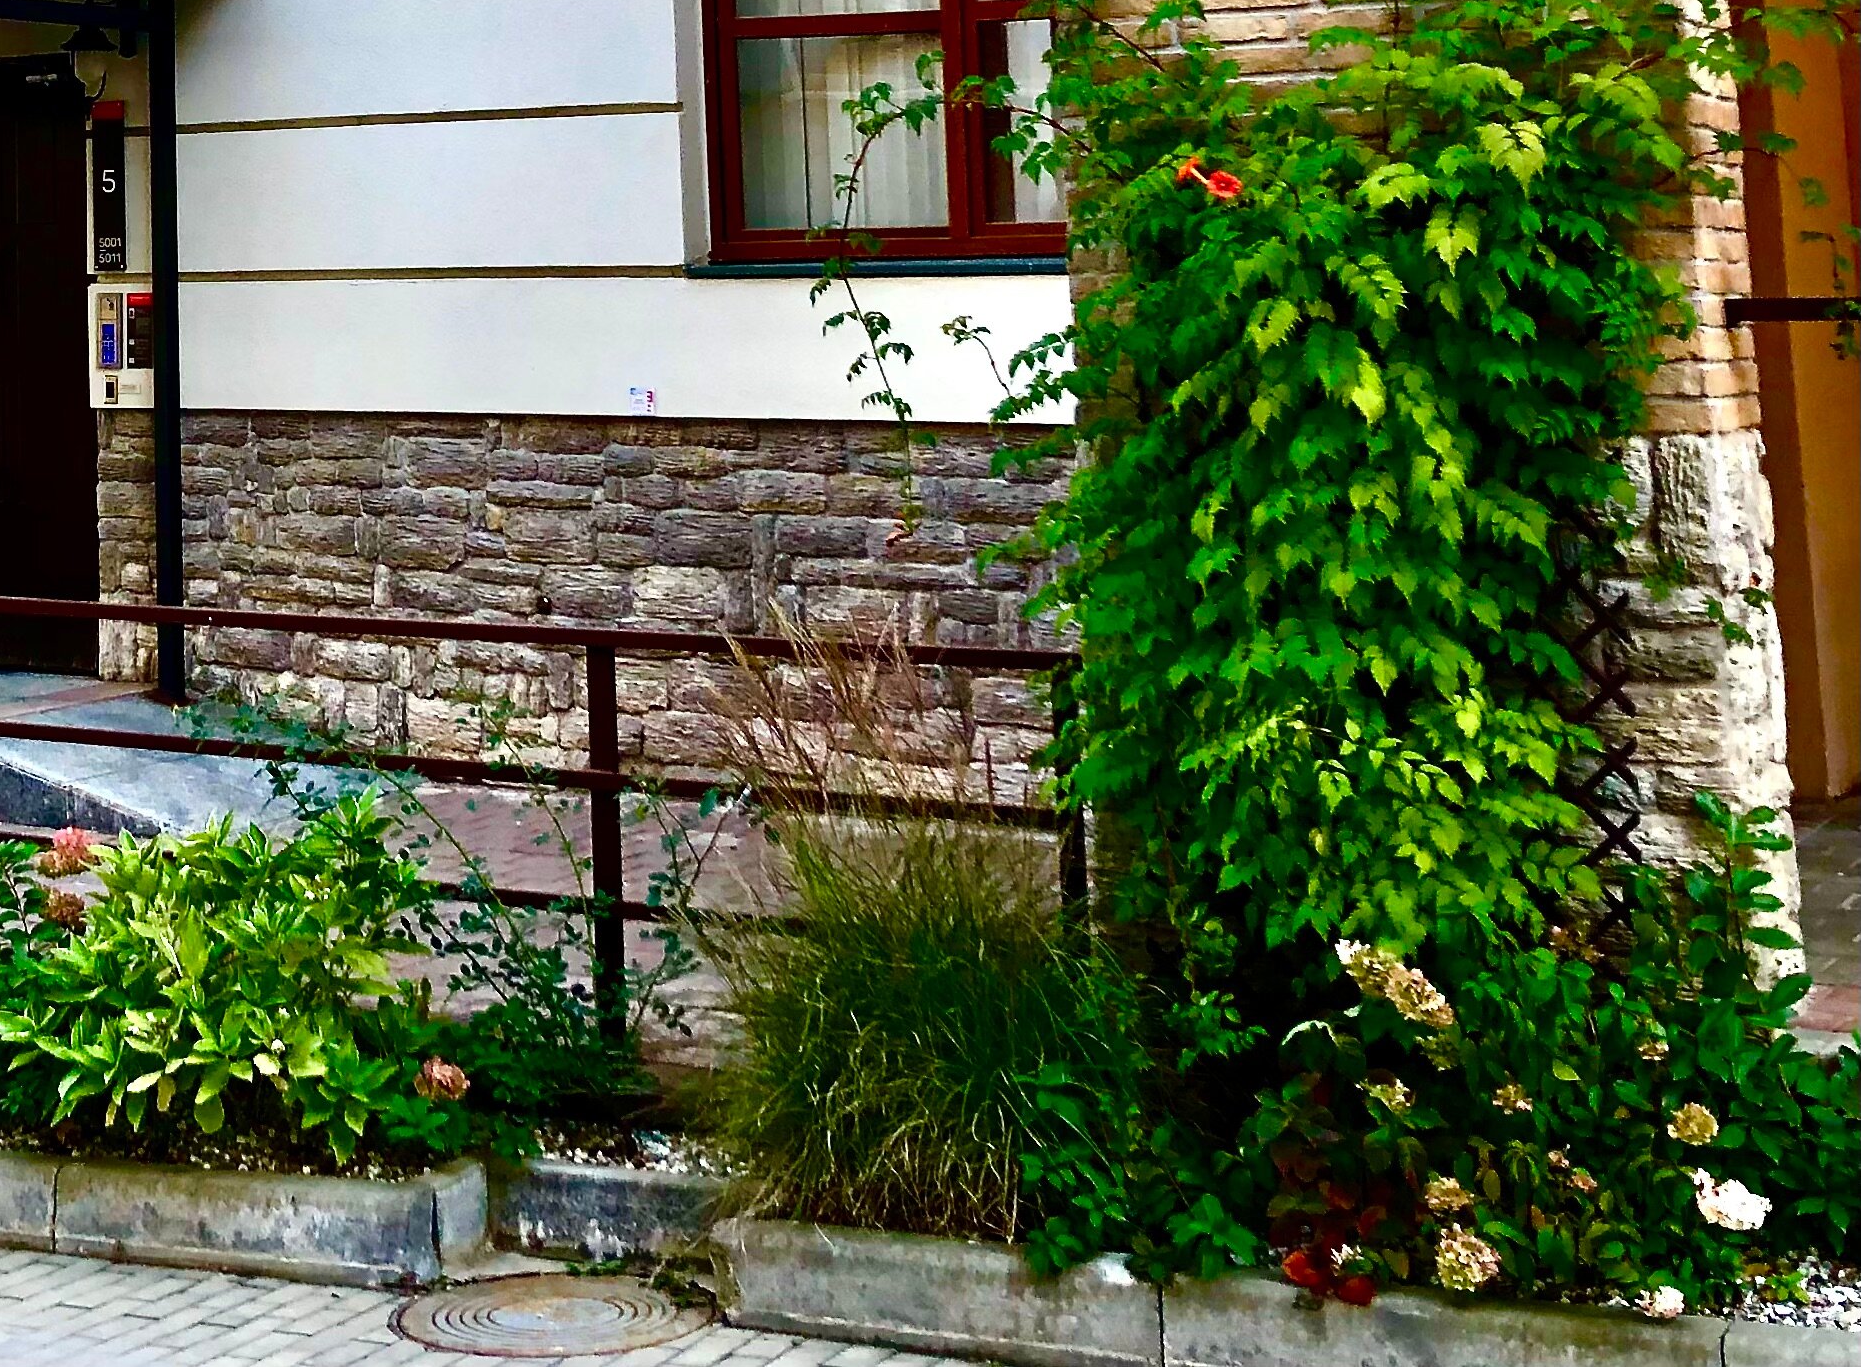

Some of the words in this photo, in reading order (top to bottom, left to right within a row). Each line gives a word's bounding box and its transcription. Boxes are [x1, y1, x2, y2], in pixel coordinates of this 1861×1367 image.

[102, 169, 116, 193] 5
[98, 237, 122, 248] 5001
[98, 252, 121, 263] 5011
